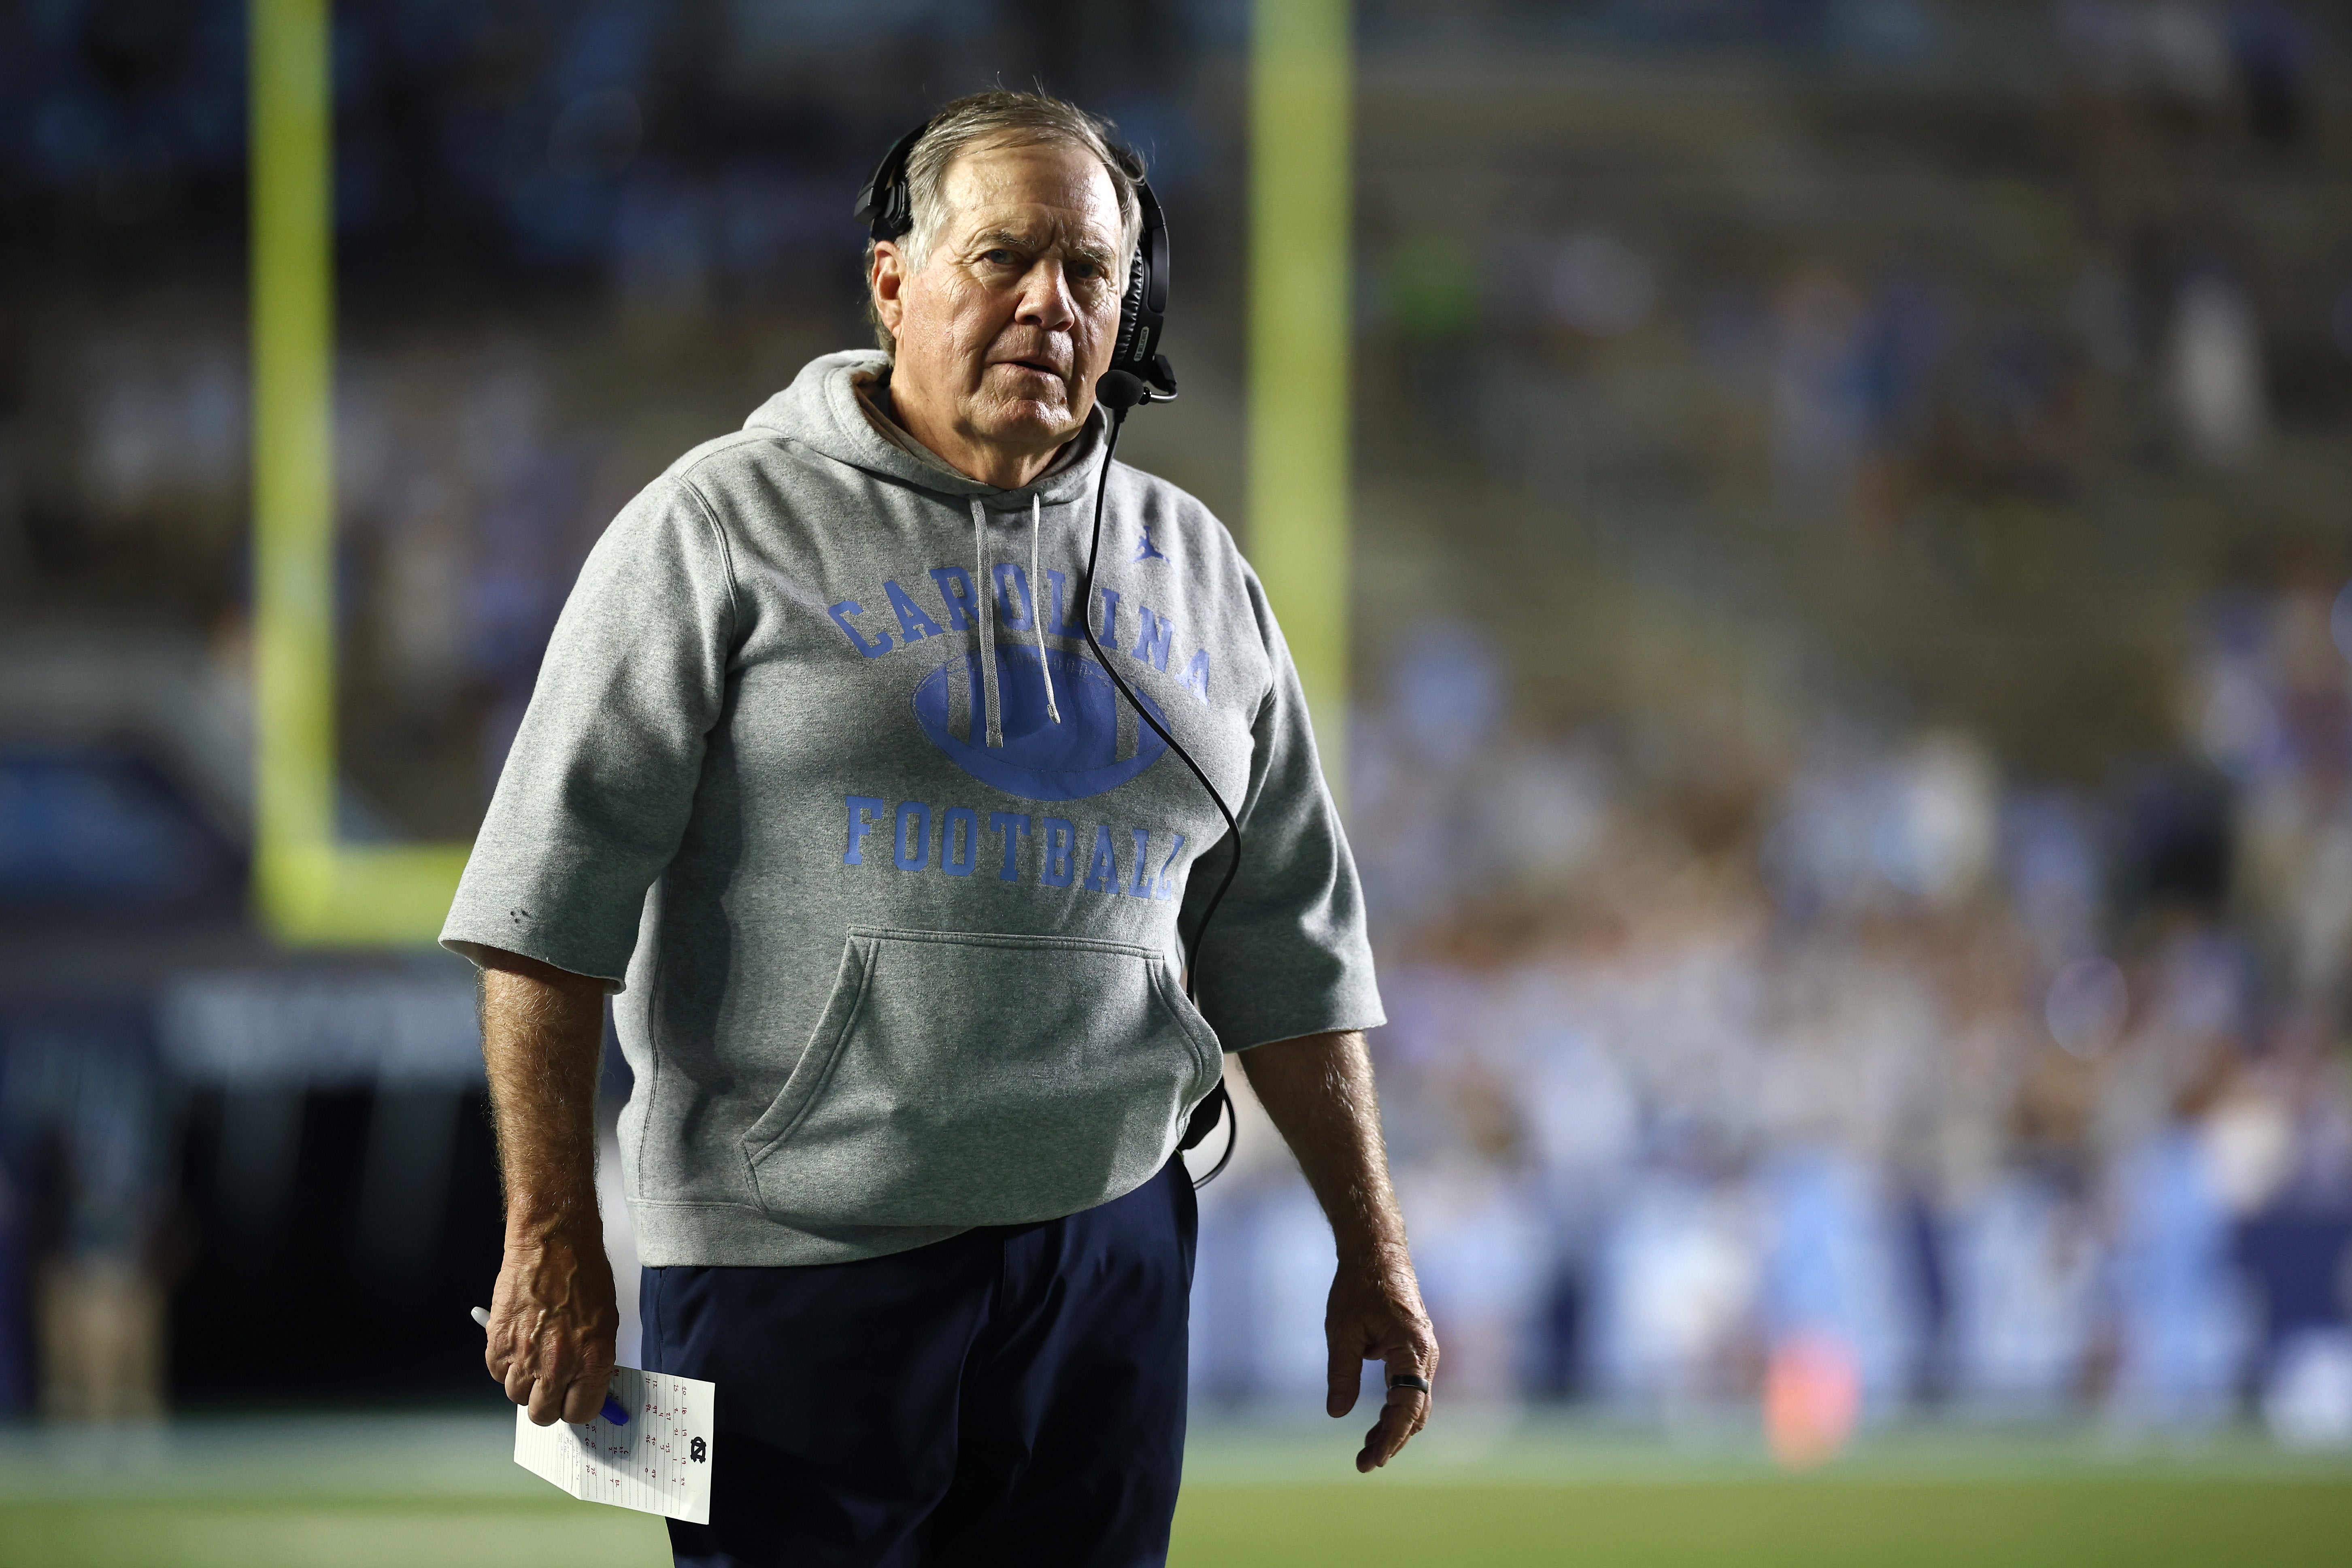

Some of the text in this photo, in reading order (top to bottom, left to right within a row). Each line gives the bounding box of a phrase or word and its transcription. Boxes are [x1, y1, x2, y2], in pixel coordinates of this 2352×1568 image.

[828, 563, 1210, 705] CAROLINA
[843, 795, 1185, 900] FOOTBALL
[653, 1380, 657, 1389] 12
[682, 1386, 687, 1396] 20
[646, 1404, 651, 1412] 92
[653, 1405, 657, 1414] 99
[665, 1412, 671, 1453] 27 33
[646, 1434, 650, 1443] 95
[681, 1477, 685, 1486] 24
